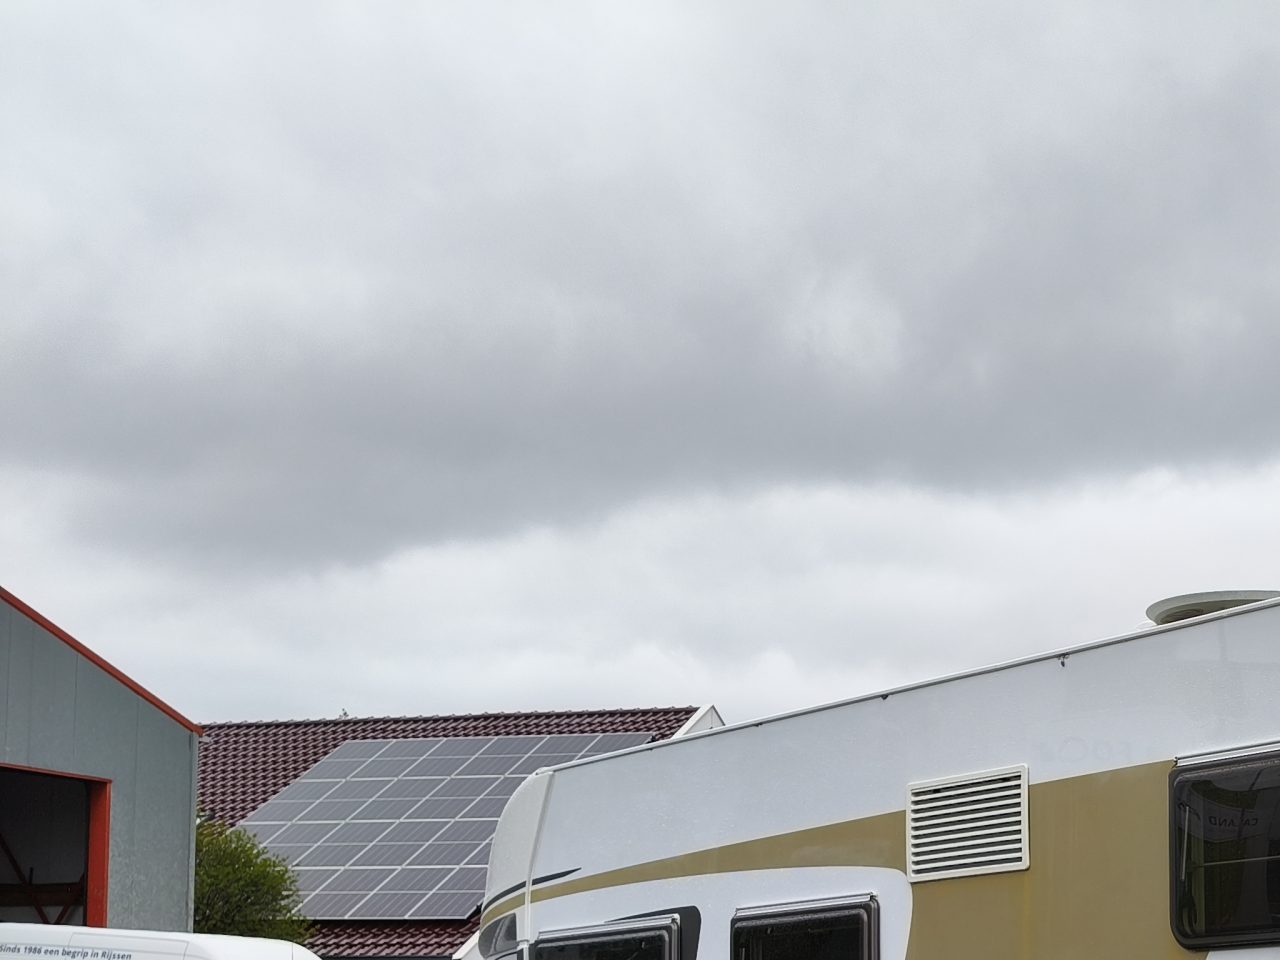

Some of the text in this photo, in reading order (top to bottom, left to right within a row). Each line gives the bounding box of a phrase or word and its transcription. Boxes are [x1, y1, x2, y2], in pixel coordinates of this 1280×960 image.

[43, 949, 60, 957] een
[61, 946, 89, 960] begrip
[90, 948, 99, 959] in
